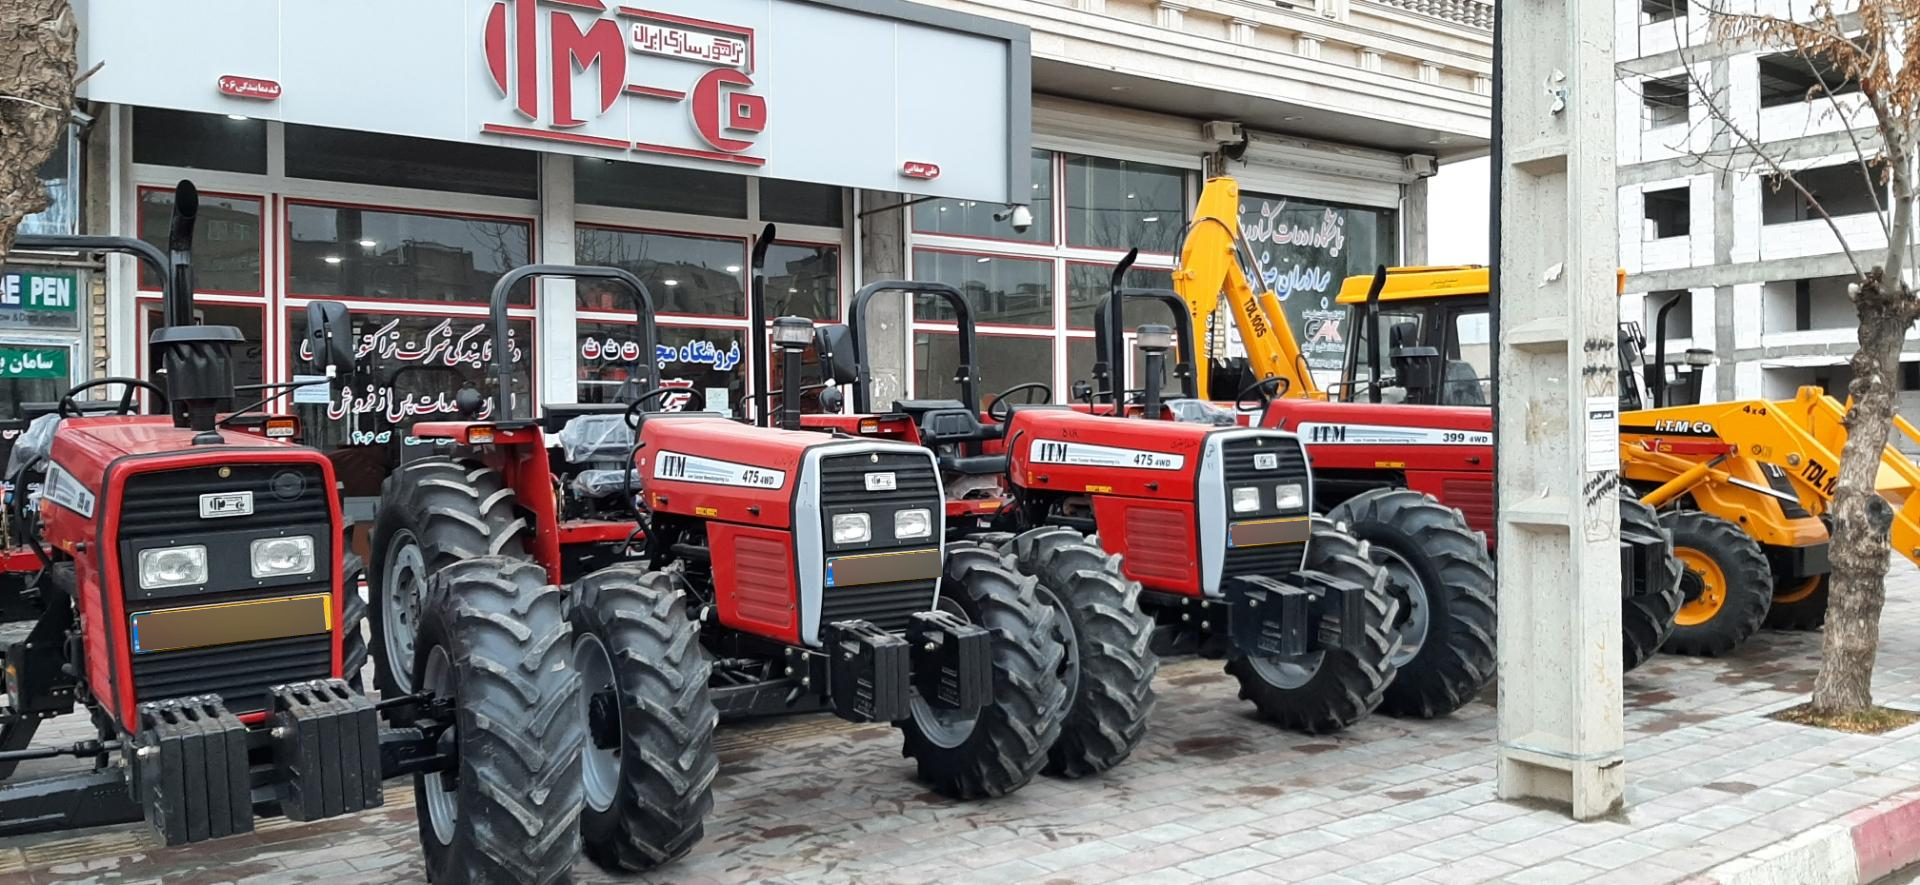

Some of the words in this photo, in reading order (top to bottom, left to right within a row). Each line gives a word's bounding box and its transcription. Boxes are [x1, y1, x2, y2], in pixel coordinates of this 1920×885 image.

[633, 23, 663, 51] ایران
[30, 276, 70, 307] PEN
[1243, 297, 1258, 319] TDL
[395, 317, 453, 365] شرکت
[679, 338, 741, 371] فروشگاه
[9, 352, 54, 374] سامان
[327, 383, 377, 420] فروش
[1312, 425, 1346, 443] ITM
[1442, 433, 1465, 443] 399
[1039, 443, 1068, 463] ITM
[1133, 453, 1154, 467] 475
[1155, 459, 1171, 468] 4WD
[662, 455, 687, 478] ITM
[742, 470, 760, 484] 475
[760, 475, 775, 486] 4WD
[1801, 459, 1828, 488] TDL
